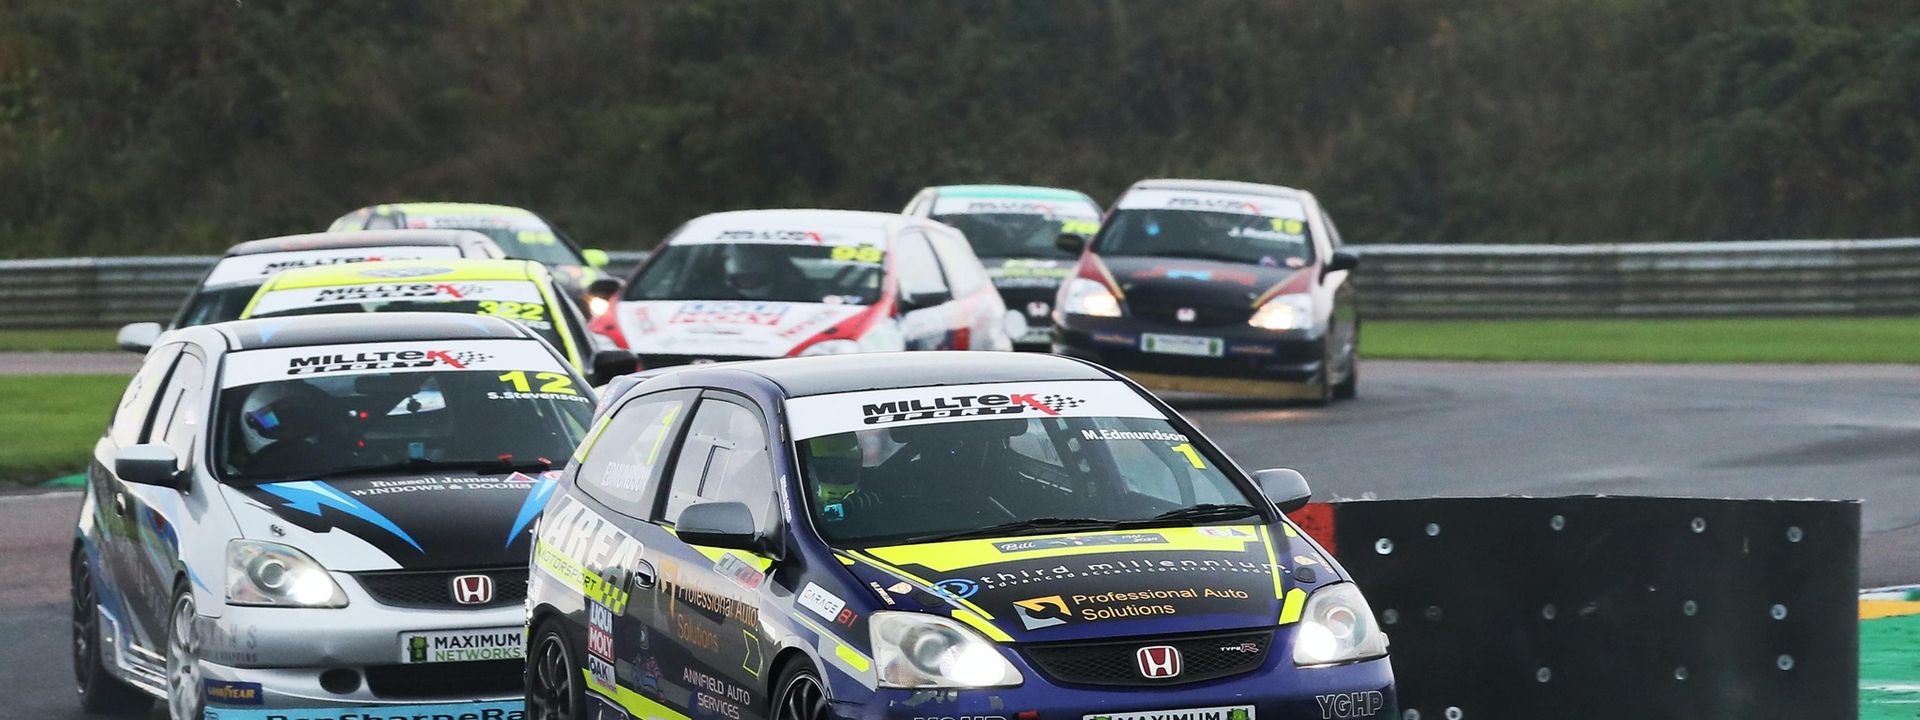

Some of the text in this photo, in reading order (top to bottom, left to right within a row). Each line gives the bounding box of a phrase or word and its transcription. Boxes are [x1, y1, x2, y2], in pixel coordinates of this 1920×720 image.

[477, 300, 544, 321] 322
[498, 371, 577, 395] 12
[487, 391, 590, 404] S.Stevenson
[874, 406, 1010, 424] SPORT
[1081, 429, 1190, 443] M.Edmundson
[1170, 443, 1207, 469] 1
[351, 482, 532, 497] WINDOWS & DOORS
[369, 476, 501, 488] Russell James
[1001, 540, 1036, 552] Bill
[980, 559, 1287, 584] third millennium
[988, 571, 1075, 591] advanced
[678, 576, 758, 628] Professional Auto
[803, 589, 839, 614] GARAGE
[1072, 587, 1249, 605] Professional Auto
[838, 608, 858, 628] 81
[1081, 603, 1176, 621] Solutions
[434, 633, 521, 650] MAXIMUM
[589, 626, 614, 659] MOLY
[678, 614, 720, 653] Solutions
[435, 647, 521, 662] NETWORKS
[1240, 643, 1260, 653] R
[589, 656, 608, 681] OAK
[683, 667, 751, 706] ANNFIELD AUTO
[697, 692, 740, 720] SERVICES
[1315, 690, 1384, 720] YGHP
